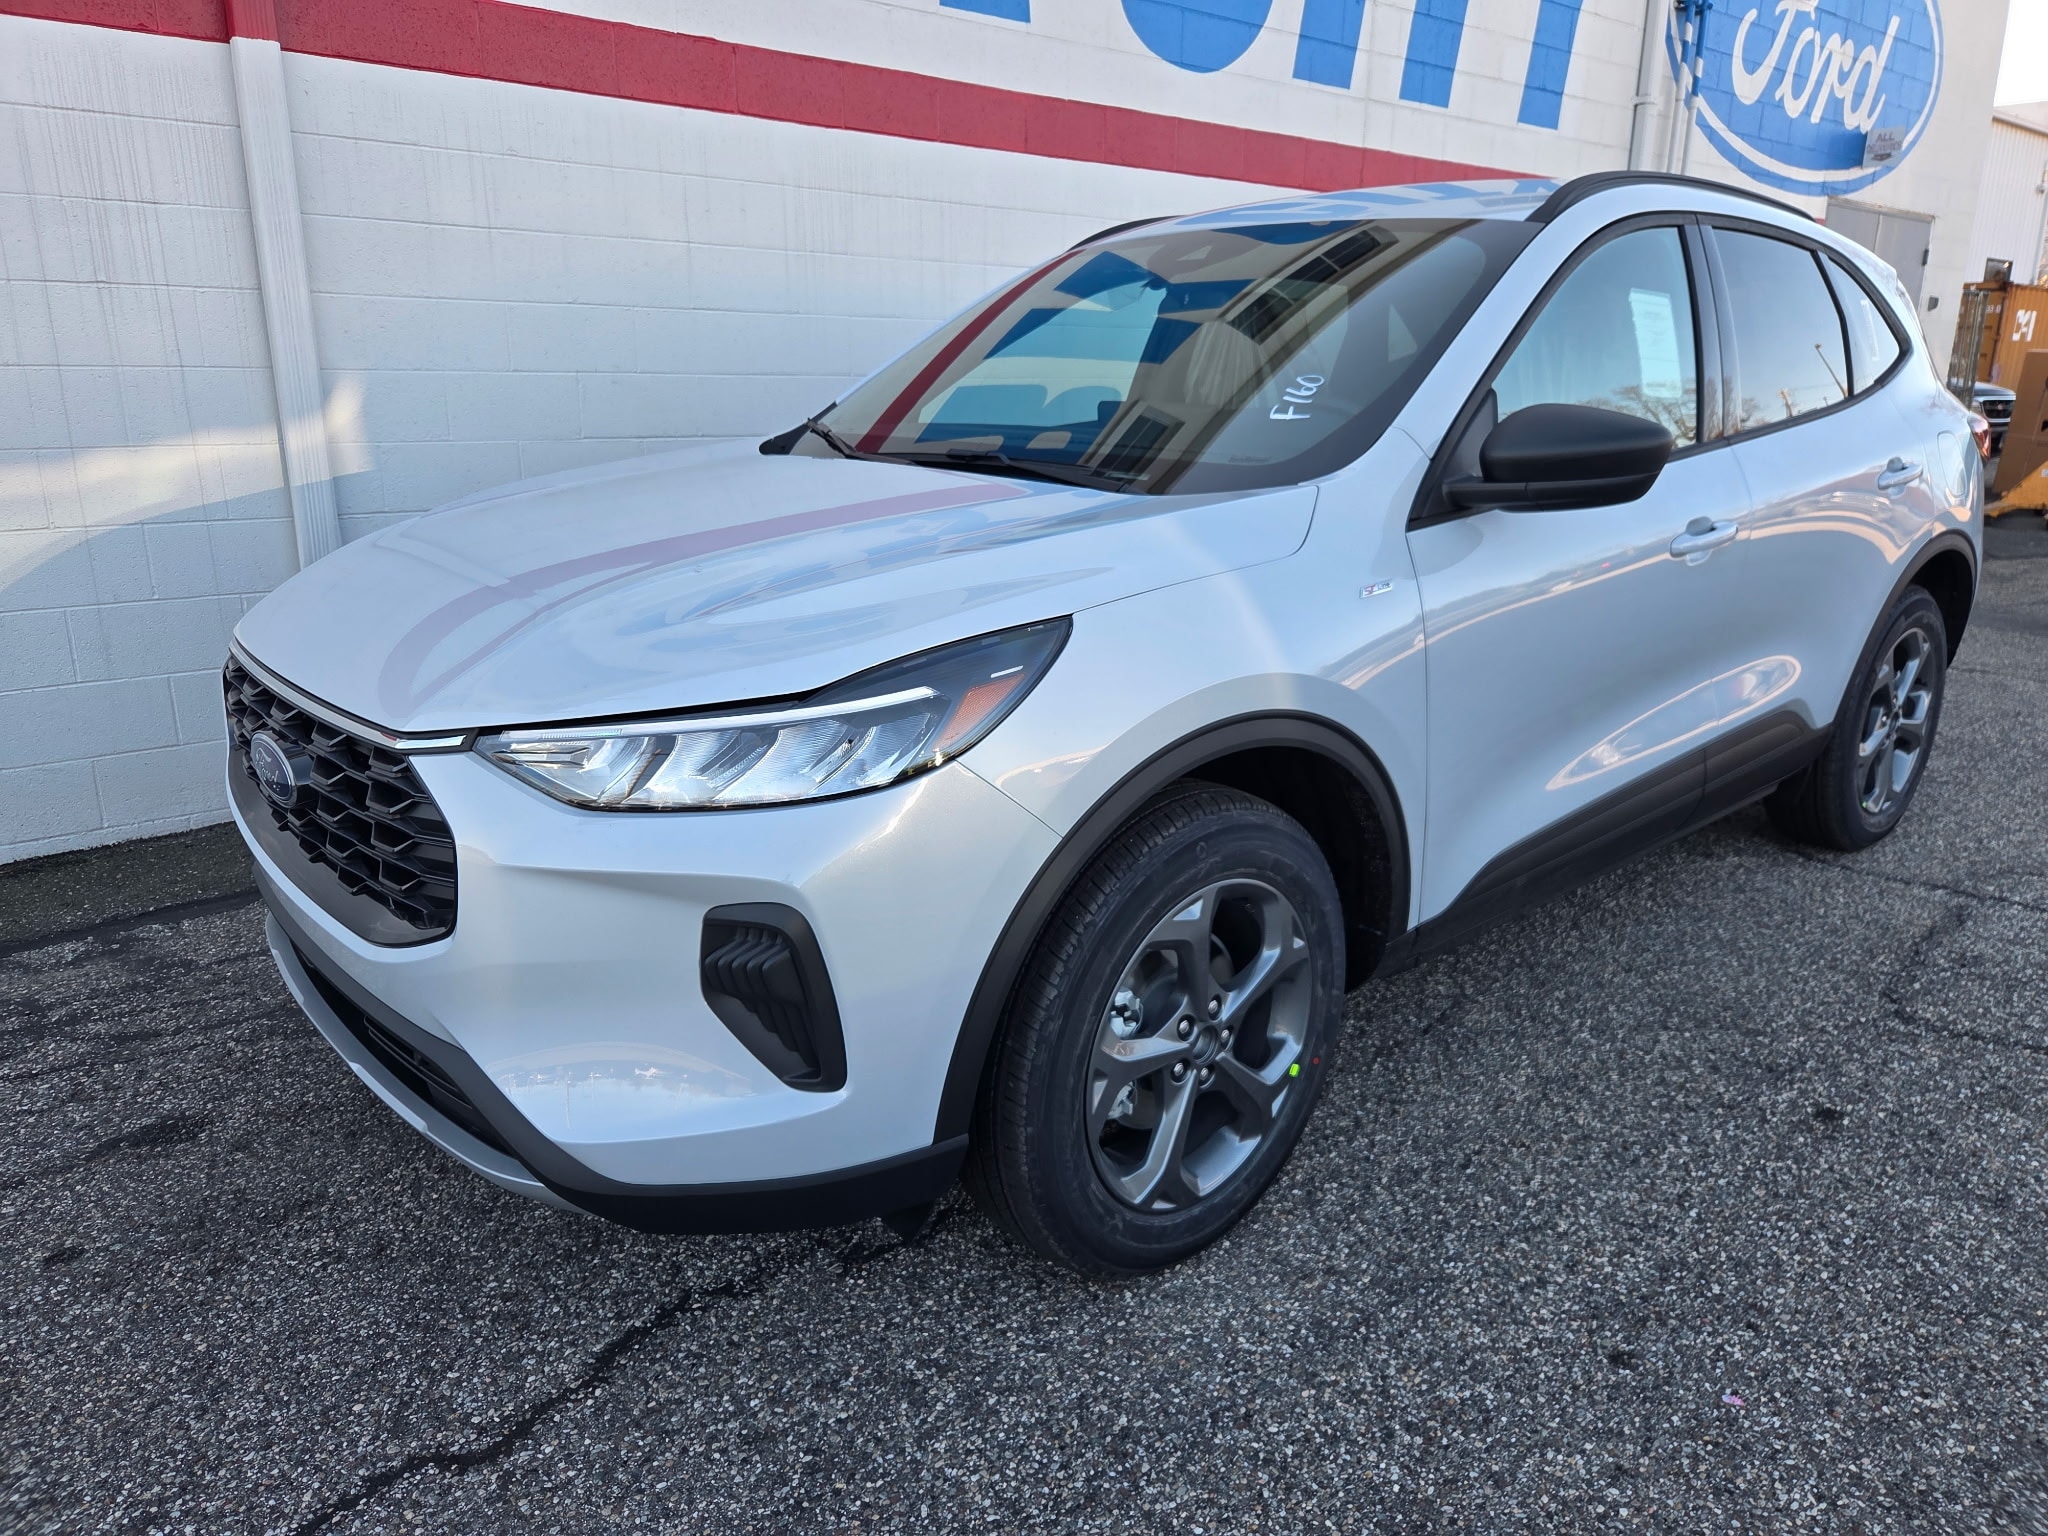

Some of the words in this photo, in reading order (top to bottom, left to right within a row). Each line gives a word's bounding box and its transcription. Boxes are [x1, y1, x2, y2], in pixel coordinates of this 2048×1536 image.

[1732, 0, 1901, 134] Ford
[1875, 131, 1896, 142] ALL
[1269, 374, 1325, 420] F160
